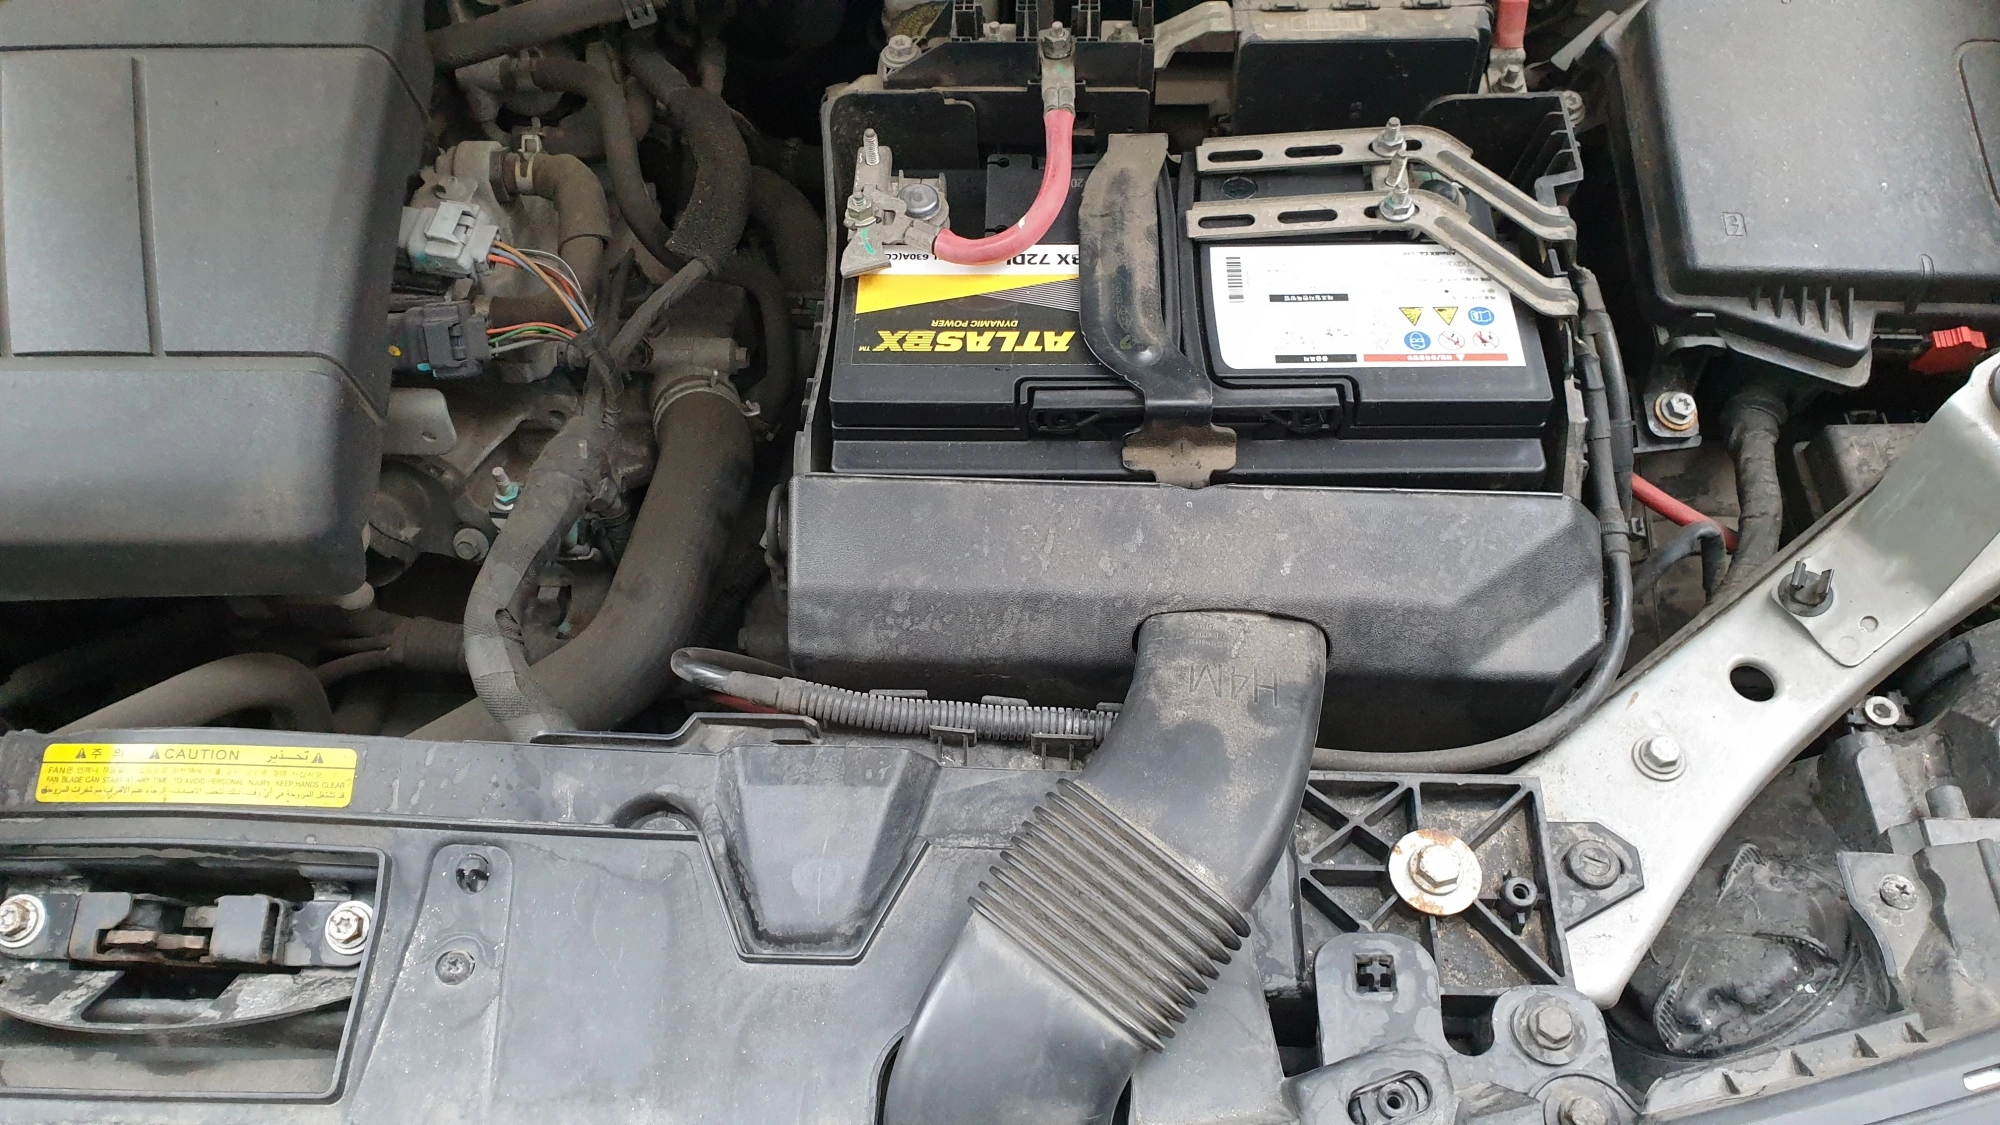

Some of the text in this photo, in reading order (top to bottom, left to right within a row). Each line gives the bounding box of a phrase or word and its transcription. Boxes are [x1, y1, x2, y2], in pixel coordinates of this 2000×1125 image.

[931, 319, 1018, 328] DYNAMIC POWER
[872, 330, 1076, 353] ATLASBX
[1189, 663, 1279, 708] H4M
[165, 748, 240, 760] CAUTION
[45, 775, 59, 784] FAN
[61, 775, 83, 784] BLADE
[85, 775, 100, 784] CAN
[184, 777, 206, 785] AVOID
[295, 781, 319, 789] HANDS
[321, 782, 345, 790] CLEAR
